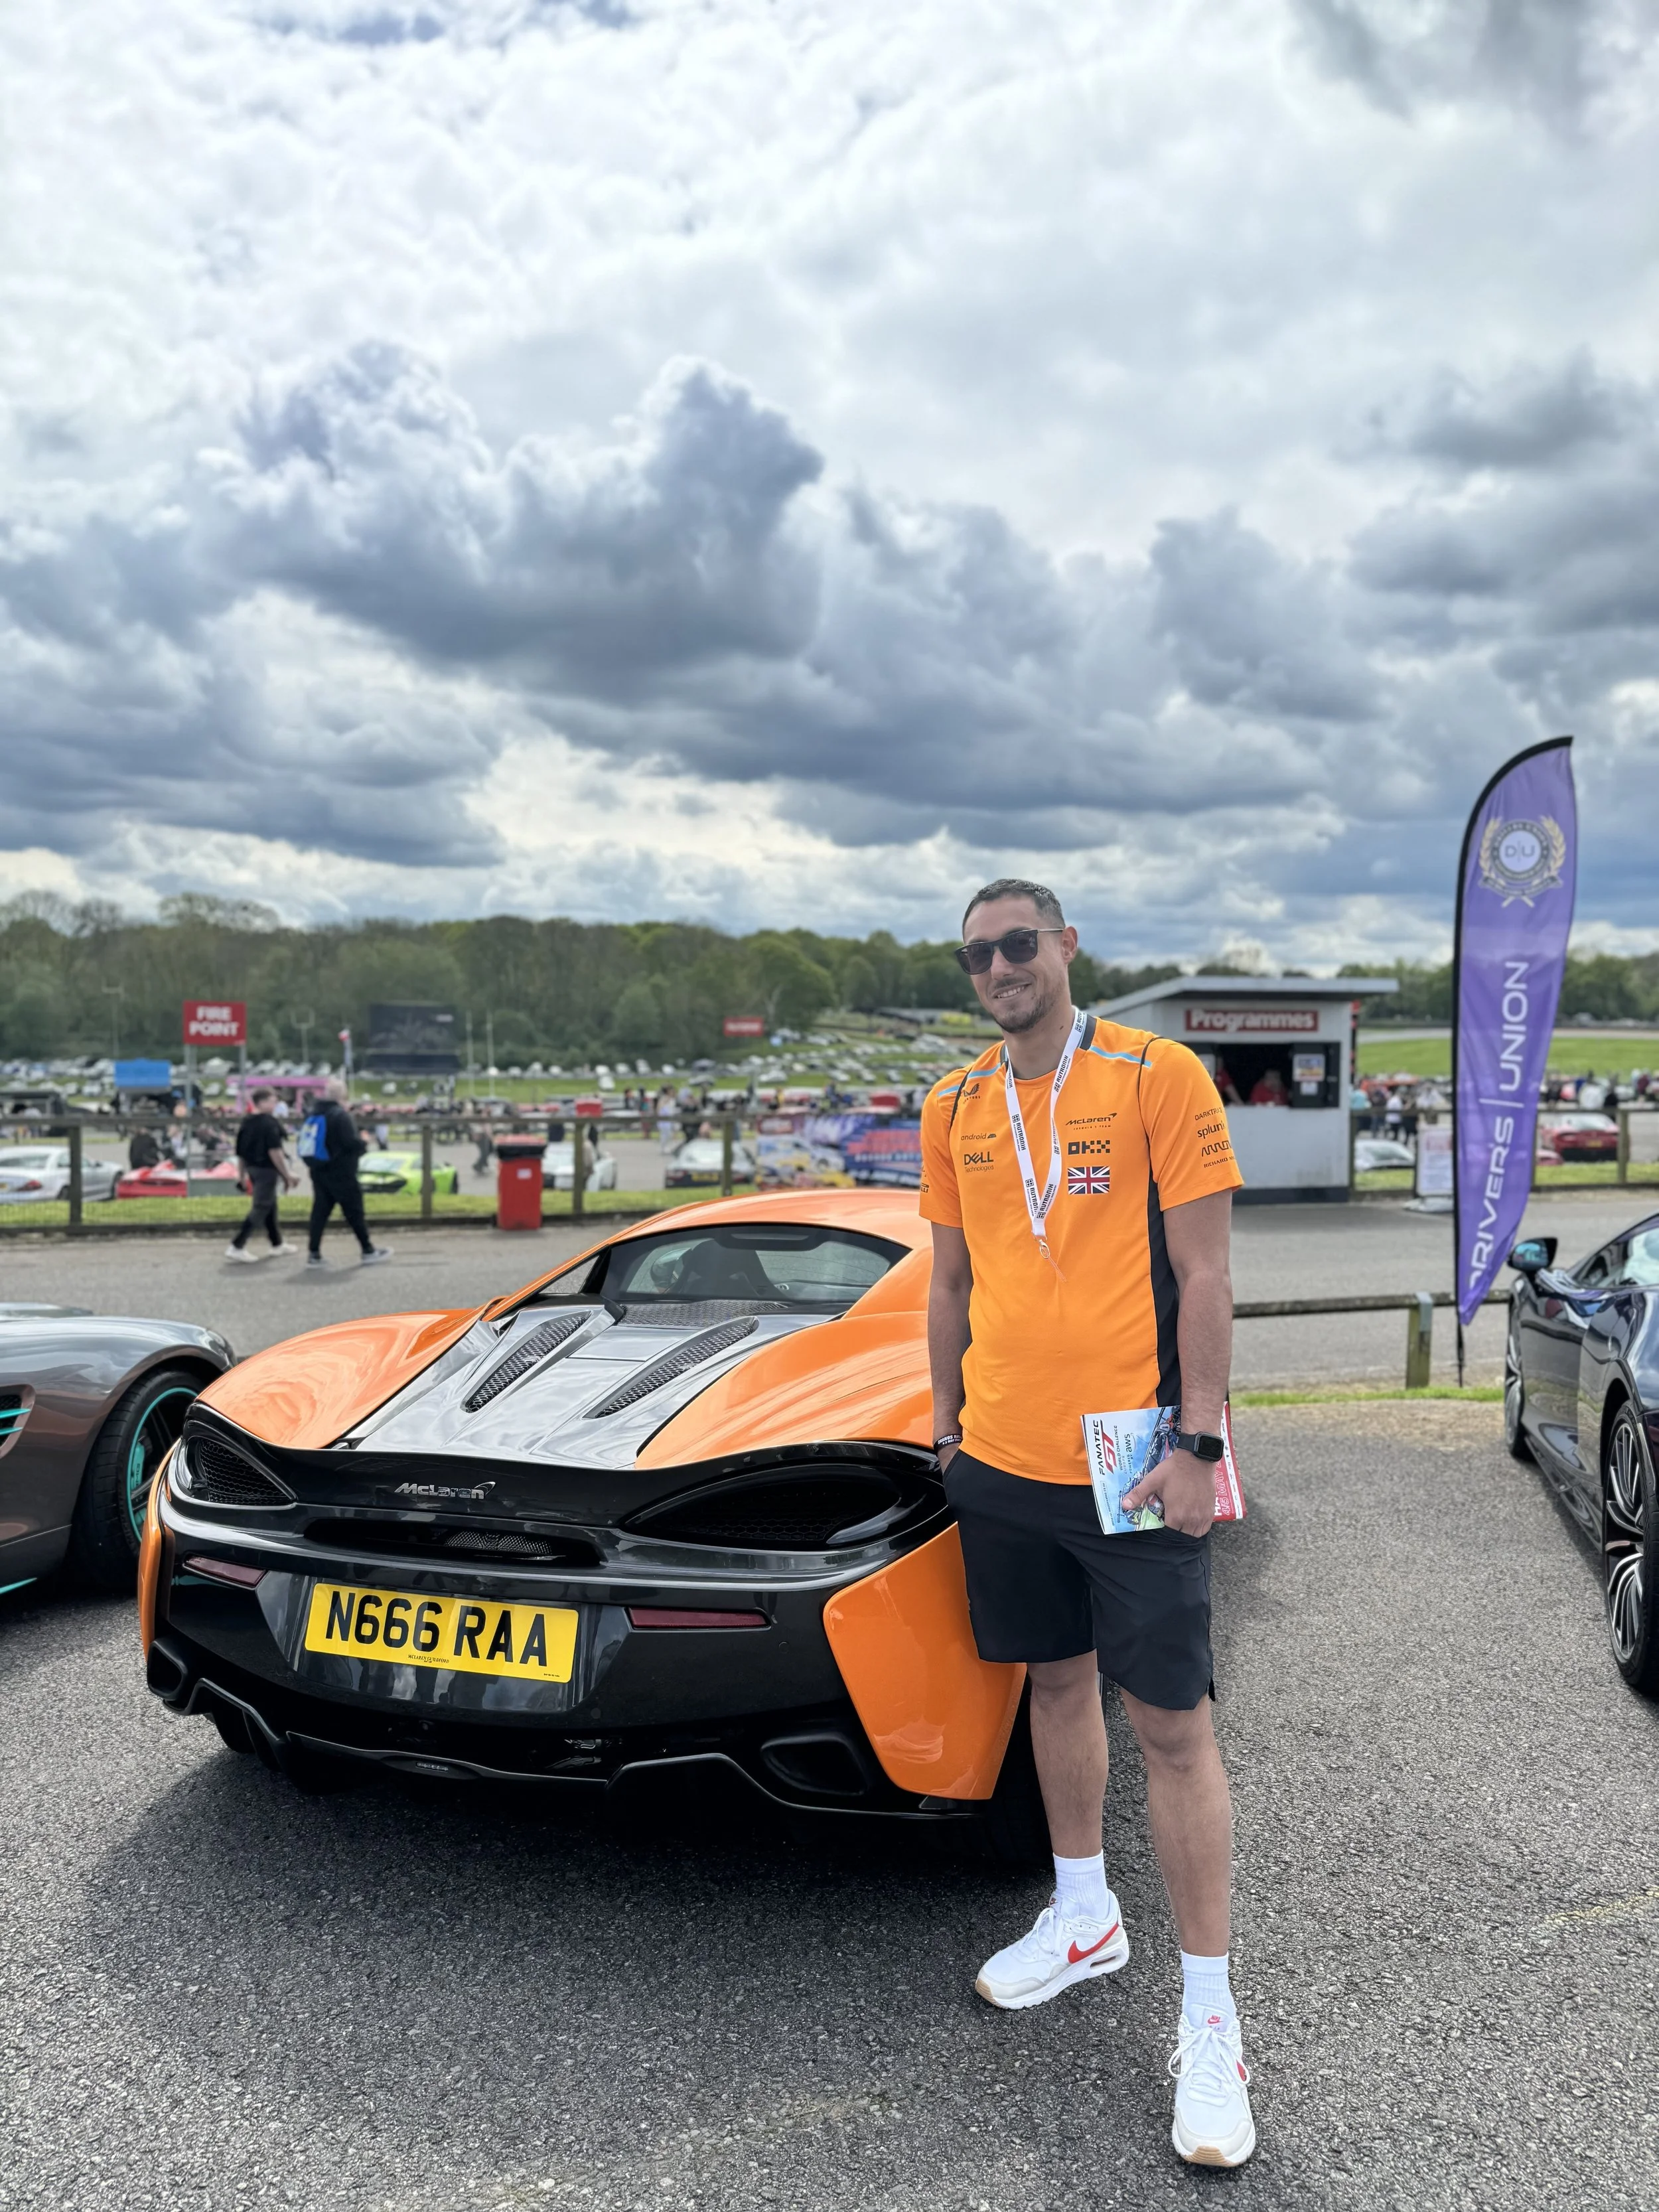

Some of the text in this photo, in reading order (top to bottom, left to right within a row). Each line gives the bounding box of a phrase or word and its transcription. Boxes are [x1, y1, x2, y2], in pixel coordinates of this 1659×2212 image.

[196, 1005, 232, 1021] FIRE
[1190, 1008, 1315, 1033] Programmes
[189, 1021, 240, 1036] POINT
[1498, 960, 1530, 1092] UNION
[1065, 1116, 1112, 1126] McLaren
[1068, 1140, 1110, 1155] OKX
[964, 1151, 994, 1165] DELL
[1204, 1157, 1228, 1168] RICHARD
[964, 1165, 994, 1173] Technologies
[1093, 1420, 1105, 1476] FANATEC
[394, 1483, 485, 1499] McLaren
[1215, 1470, 1228, 1496] MAY
[325, 1591, 547, 1666] N666 RAA
